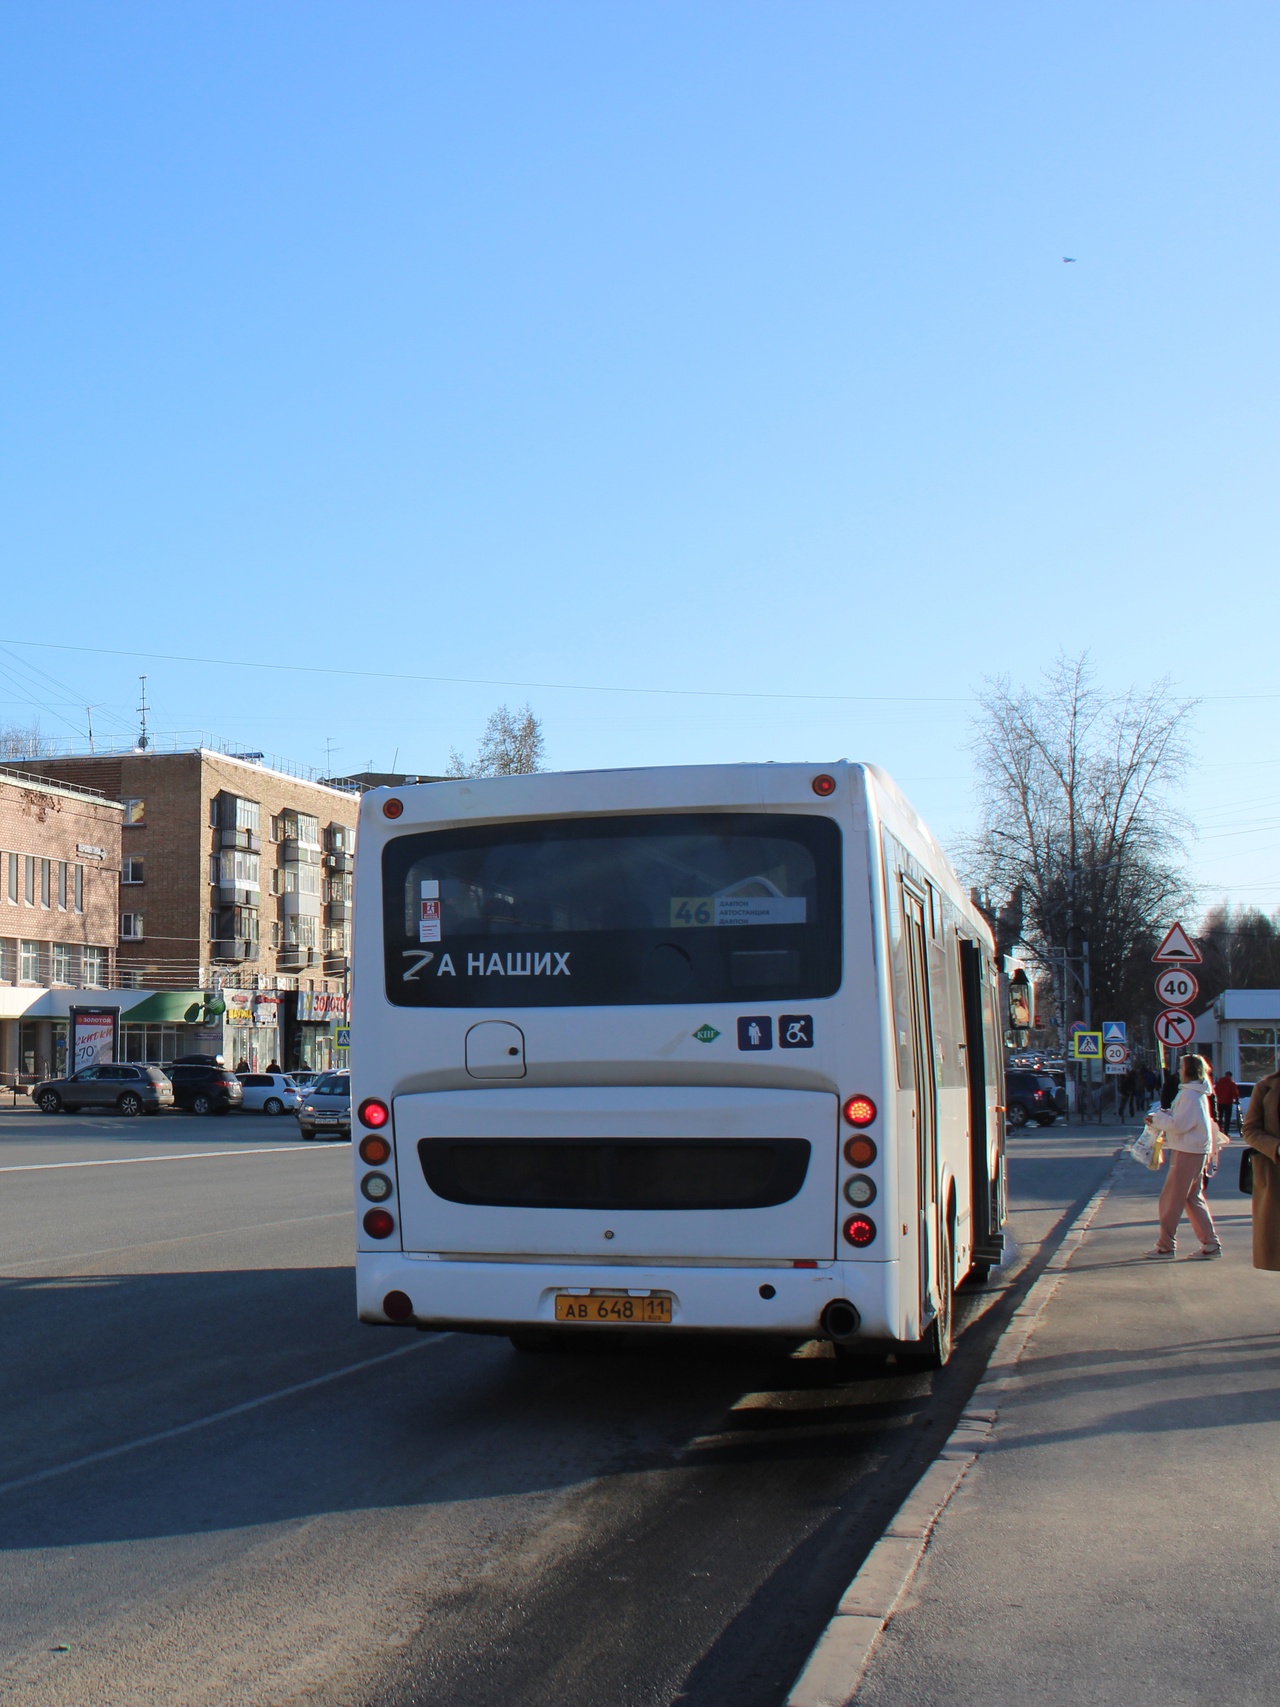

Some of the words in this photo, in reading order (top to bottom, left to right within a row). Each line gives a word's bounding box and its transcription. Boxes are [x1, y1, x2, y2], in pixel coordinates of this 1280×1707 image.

[675, 901, 711, 925] 46
[467, 952, 571, 976] НАШИХ
[1163, 980, 1188, 995] 40
[1109, 1049, 1121, 1058] 20
[565, 1303, 588, 1318] АВ
[597, 1300, 634, 1319] 648
[646, 1300, 665, 1315] 11
